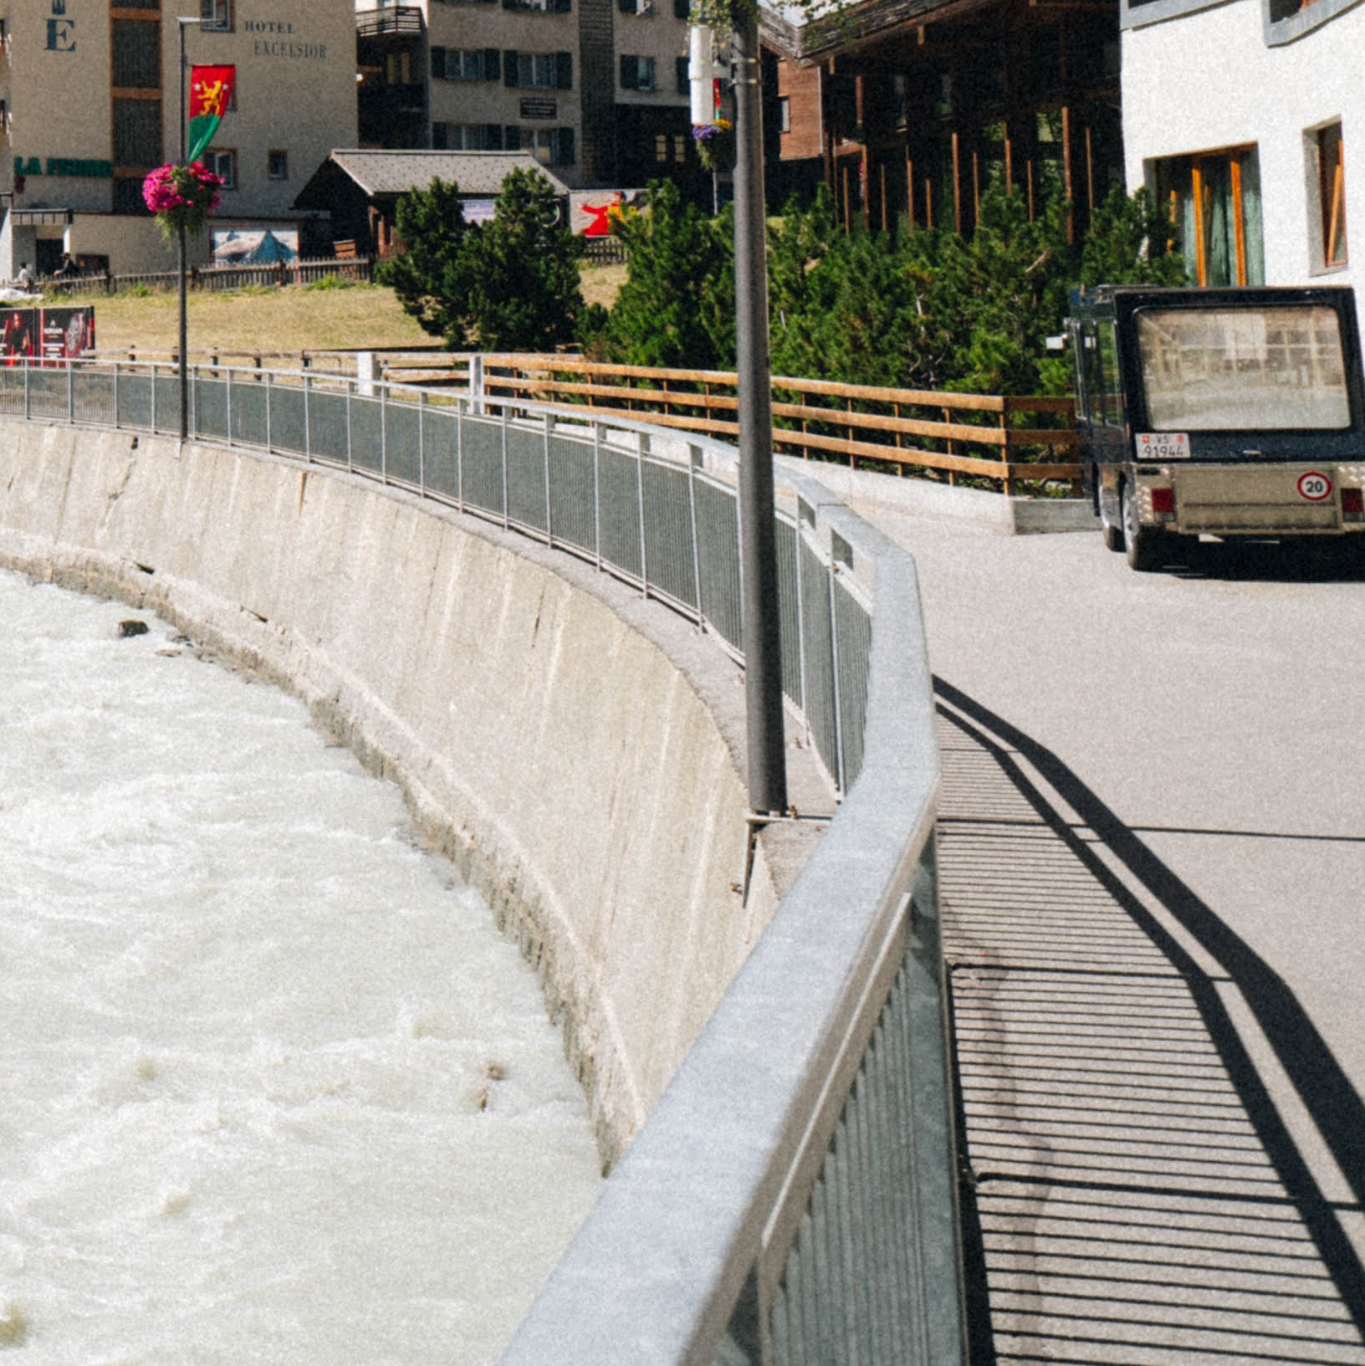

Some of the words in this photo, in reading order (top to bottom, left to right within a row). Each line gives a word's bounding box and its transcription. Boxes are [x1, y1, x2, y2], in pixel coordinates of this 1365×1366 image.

[43, 18, 76, 51] E
[245, 20, 294, 34] HOTEL
[254, 40, 327, 59] EXCELSIOR
[14, 157, 43, 175] LA
[1156, 435, 1169, 444] VS
[1306, 480, 1324, 493] 20
